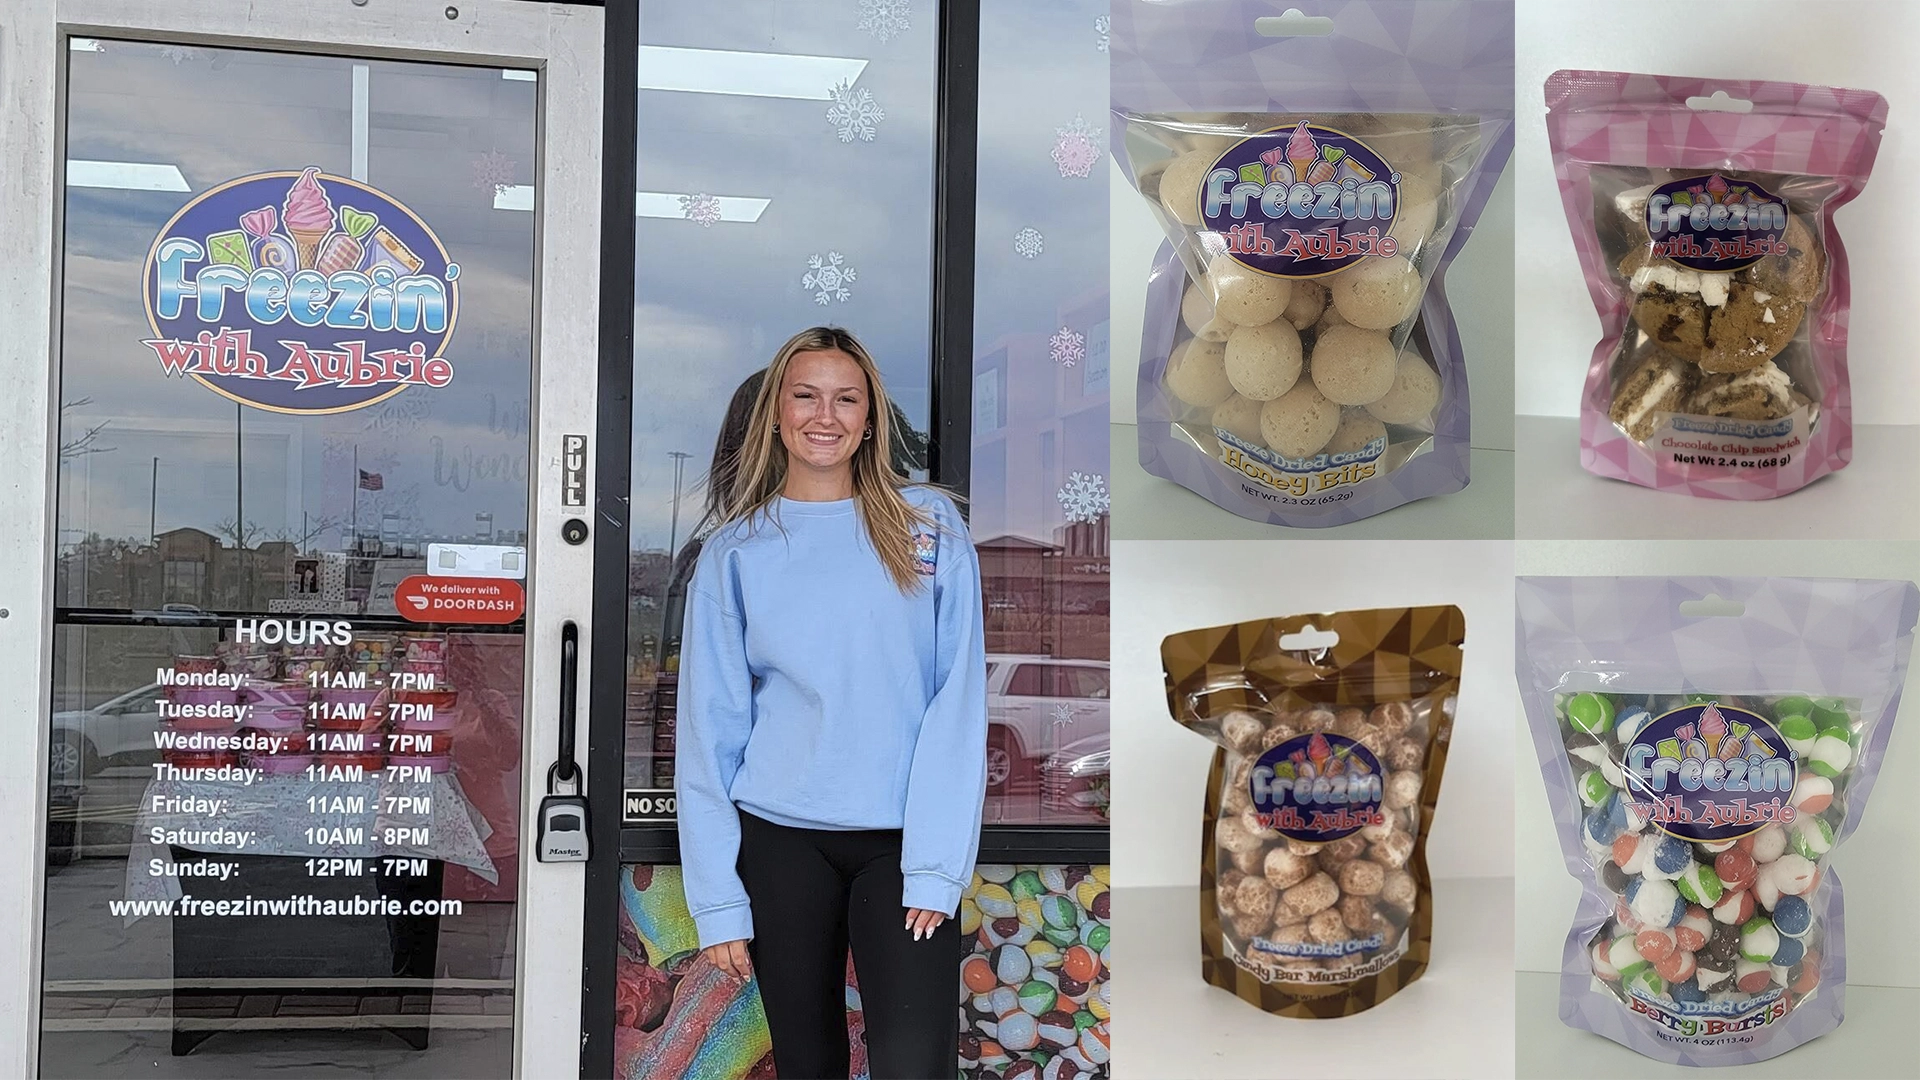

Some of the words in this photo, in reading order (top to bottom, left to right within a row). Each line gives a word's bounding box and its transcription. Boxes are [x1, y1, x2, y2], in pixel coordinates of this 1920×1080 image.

[1197, 221, 1277, 258] with
[1275, 226, 1399, 263] Aubrie
[1645, 234, 1701, 260] with
[1707, 234, 1789, 262] Aubrie
[140, 328, 269, 379] with
[268, 339, 454, 390] Aubrie
[1672, 418, 1716, 433] Freeze
[1717, 421, 1754, 438] Dried
[1756, 418, 1793, 438] Candy
[1214, 427, 1269, 460] Freeze
[1273, 453, 1327, 470] Dried
[1331, 436, 1386, 464] Candy
[1661, 438, 1718, 452] Chocolate
[1721, 442, 1749, 456] Chip
[1752, 436, 1801, 455] Sandwich
[567, 436, 583, 505] PULL
[1223, 446, 1309, 496] Honey
[1316, 463, 1377, 491] Bits
[1674, 453, 1695, 465] Net
[1698, 455, 1715, 466] Wt
[1718, 456, 1737, 467] 2.4
[1740, 458, 1755, 468] oz
[1757, 457, 1776, 468] (68
[1779, 454, 1791, 467] g)
[1242, 483, 1261, 497] NET
[1261, 492, 1280, 503] WT.
[1282, 497, 1298, 505] 2.3
[1300, 498, 1316, 506] OZ
[1318, 490, 1354, 506] (65.2g)
[421, 583, 439, 593] We
[440, 584, 477, 595] deliver
[478, 585, 500, 595] with
[434, 598, 515, 611] DOORDASH
[235, 619, 353, 646] HOURS
[156, 668, 250, 691] Monday:
[308, 671, 366, 689] 11AM
[389, 673, 435, 690] 7PM
[155, 700, 253, 722] Tuesday:
[308, 703, 366, 720] 11AM
[388, 704, 434, 721] 7PM
[153, 731, 289, 754] Wednesday:
[306, 734, 364, 751] 11AM
[387, 735, 432, 752] 7PM
[153, 763, 264, 786] Thursday:
[305, 765, 363, 783] 11AM
[386, 766, 432, 784] 7PM
[152, 795, 228, 817] Friday:
[306, 796, 363, 814] 11AM
[385, 797, 431, 814] 7PM
[627, 798, 652, 813] NO
[1624, 794, 1693, 824] with
[1694, 797, 1798, 829] Aubrie
[1254, 806, 1305, 830] with
[1308, 807, 1386, 834] Aubrie
[150, 827, 256, 849] Saturday:
[304, 827, 363, 845] 10AM
[384, 828, 429, 846] 8PM
[149, 859, 239, 881] Sunday:
[305, 859, 363, 877] 12PM
[382, 860, 428, 877] 7PM
[109, 895, 463, 918] www.freezinwithaubrie.com
[1253, 936, 1298, 955] Freeze
[1301, 941, 1345, 957] Dried
[1346, 933, 1384, 953] Candy
[1234, 953, 1270, 982] Candy
[1274, 969, 1304, 981] Bar
[1308, 952, 1400, 982] Marshmallows
[1629, 986, 1680, 1012] Freeze
[1683, 1000, 1734, 1016] Dried
[1734, 987, 1785, 1014] Candy
[1630, 996, 1698, 1036] Berry
[1704, 1000, 1785, 1036] Bursts
[1656, 1030, 1673, 1042] NET
[1675, 1036, 1691, 1044] WT.
[1701, 1037, 1715, 1046] OZ
[1717, 1035, 1754, 1046] (113.4g)
